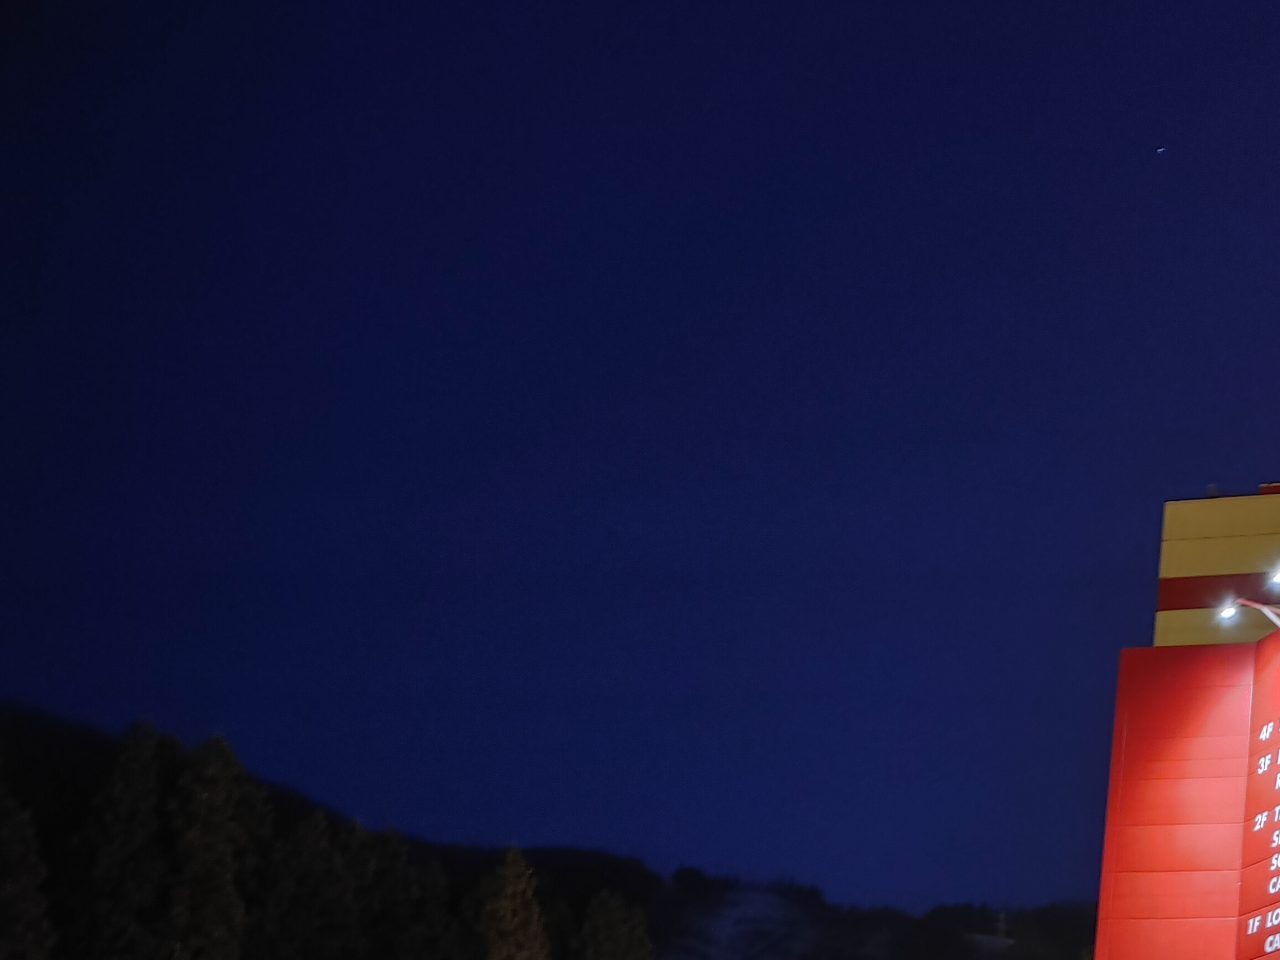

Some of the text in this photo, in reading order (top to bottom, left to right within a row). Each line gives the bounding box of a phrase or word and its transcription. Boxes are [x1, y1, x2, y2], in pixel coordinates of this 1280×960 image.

[1259, 722, 1274, 741] 4F
[1257, 756, 1271, 774] 3F
[1253, 811, 1268, 831] 2F
[1247, 917, 1262, 935] 1F
